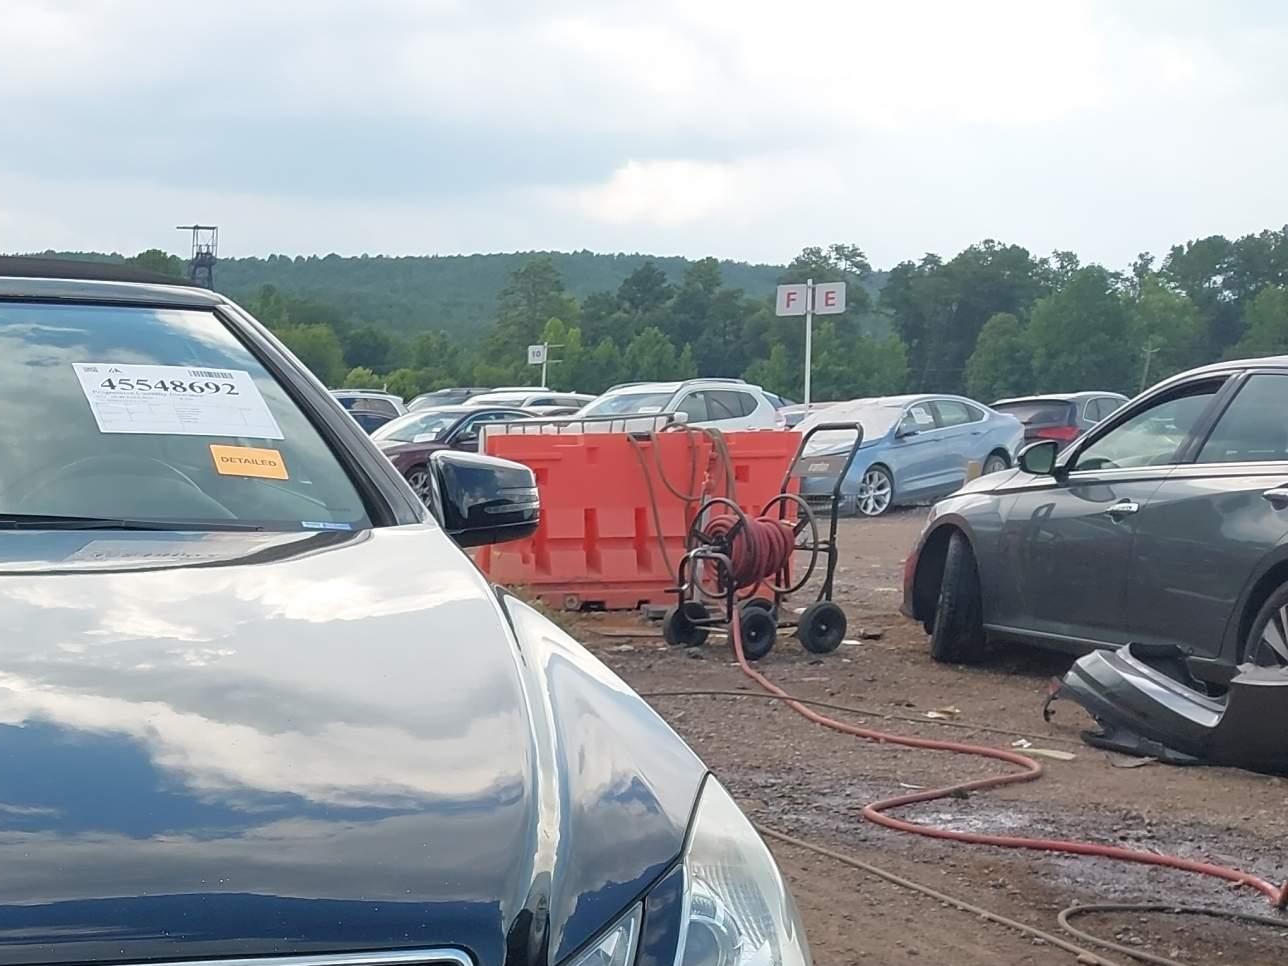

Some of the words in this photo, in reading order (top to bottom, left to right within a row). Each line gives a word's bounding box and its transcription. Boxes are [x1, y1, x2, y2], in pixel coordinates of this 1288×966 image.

[786, 291, 798, 309] F
[824, 290, 836, 307] E
[100, 377, 240, 396] 45548692
[220, 456, 278, 467] DETAILED
